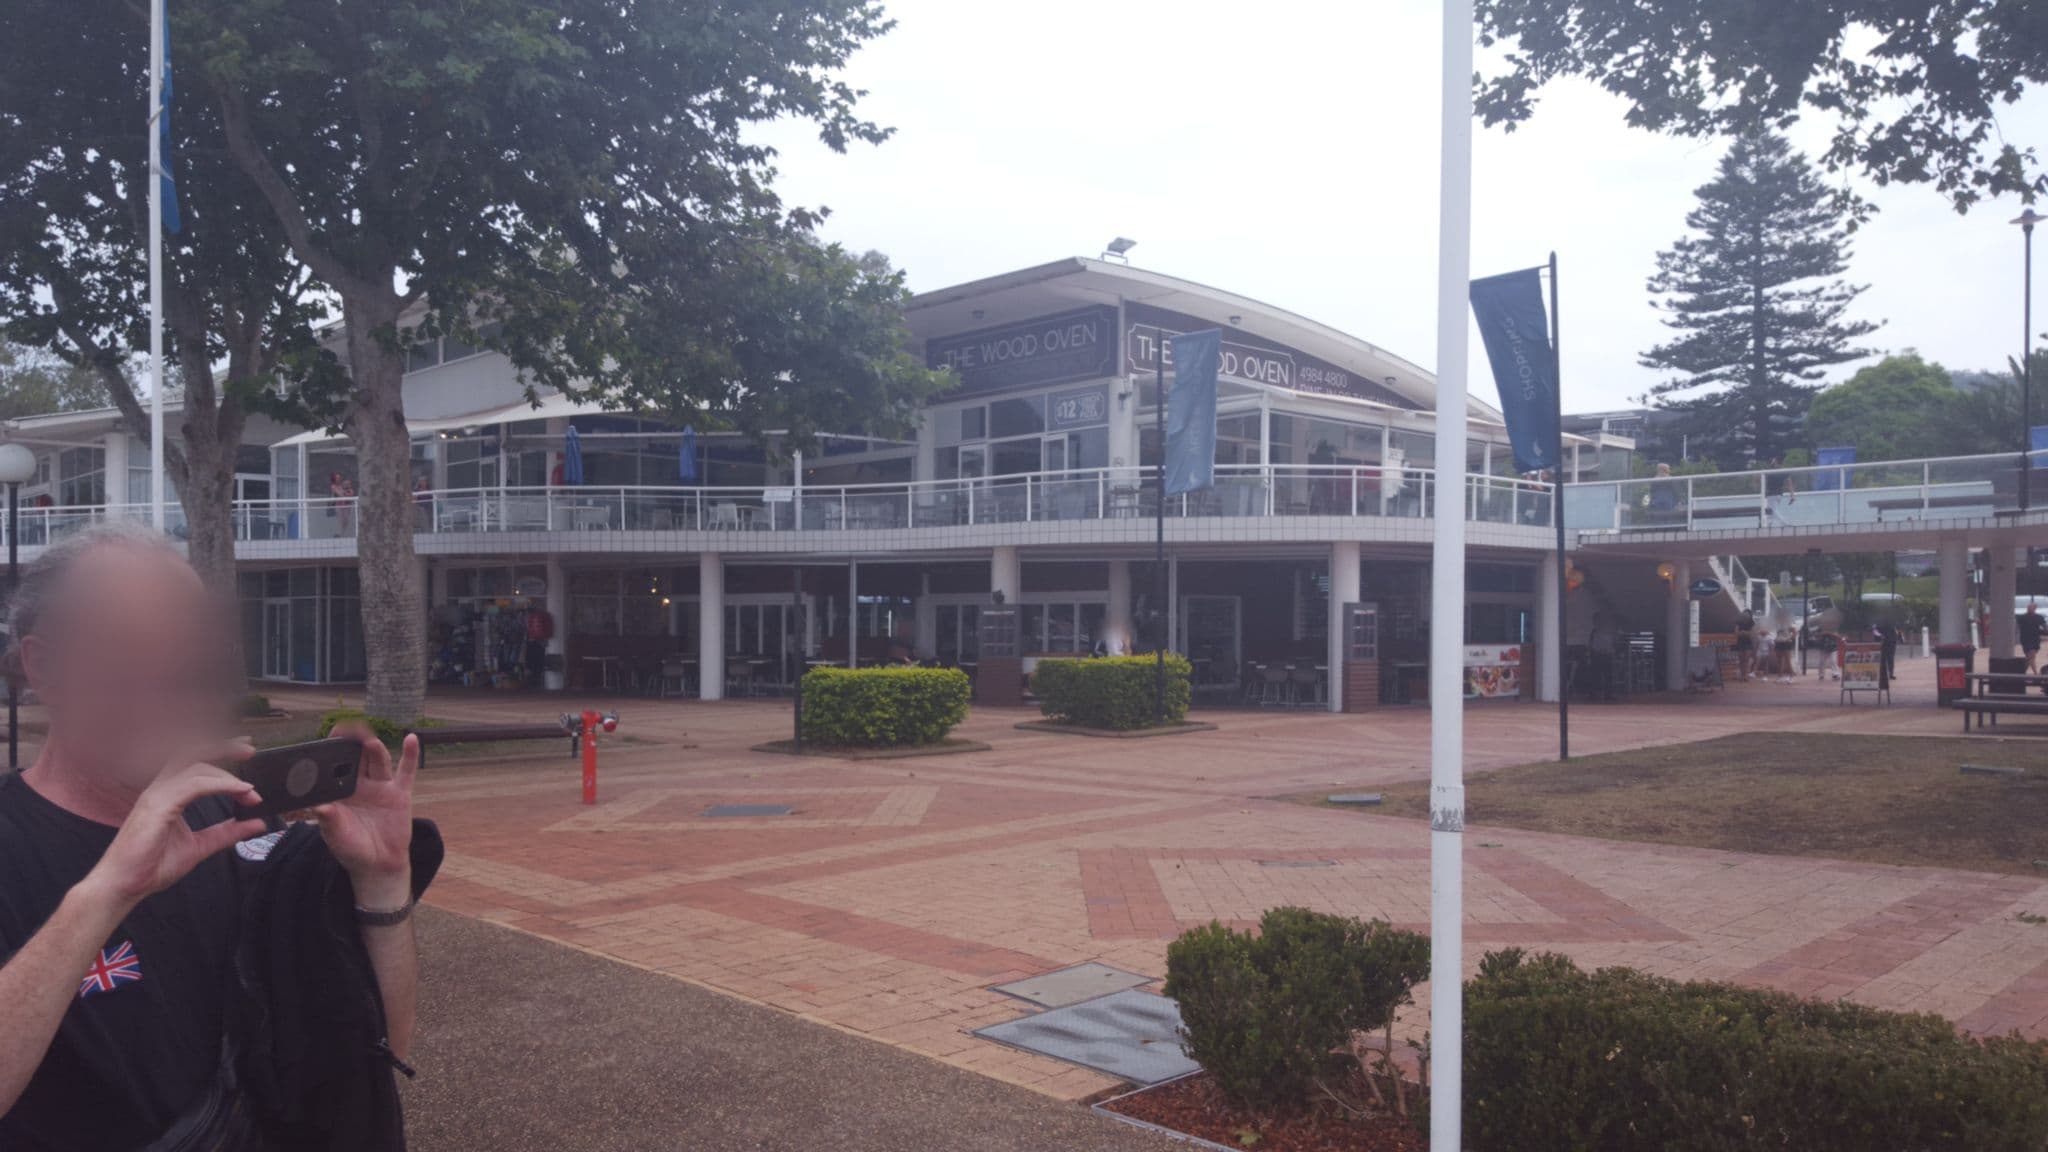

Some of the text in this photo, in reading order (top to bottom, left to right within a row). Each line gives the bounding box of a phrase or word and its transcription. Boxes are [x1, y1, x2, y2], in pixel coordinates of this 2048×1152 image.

[944, 322, 1097, 369] THE WOOD OVEN
[1137, 335, 1173, 365] THE
[1244, 356, 1289, 385] OVEN
[1299, 367, 1348, 388] 4984 4800
